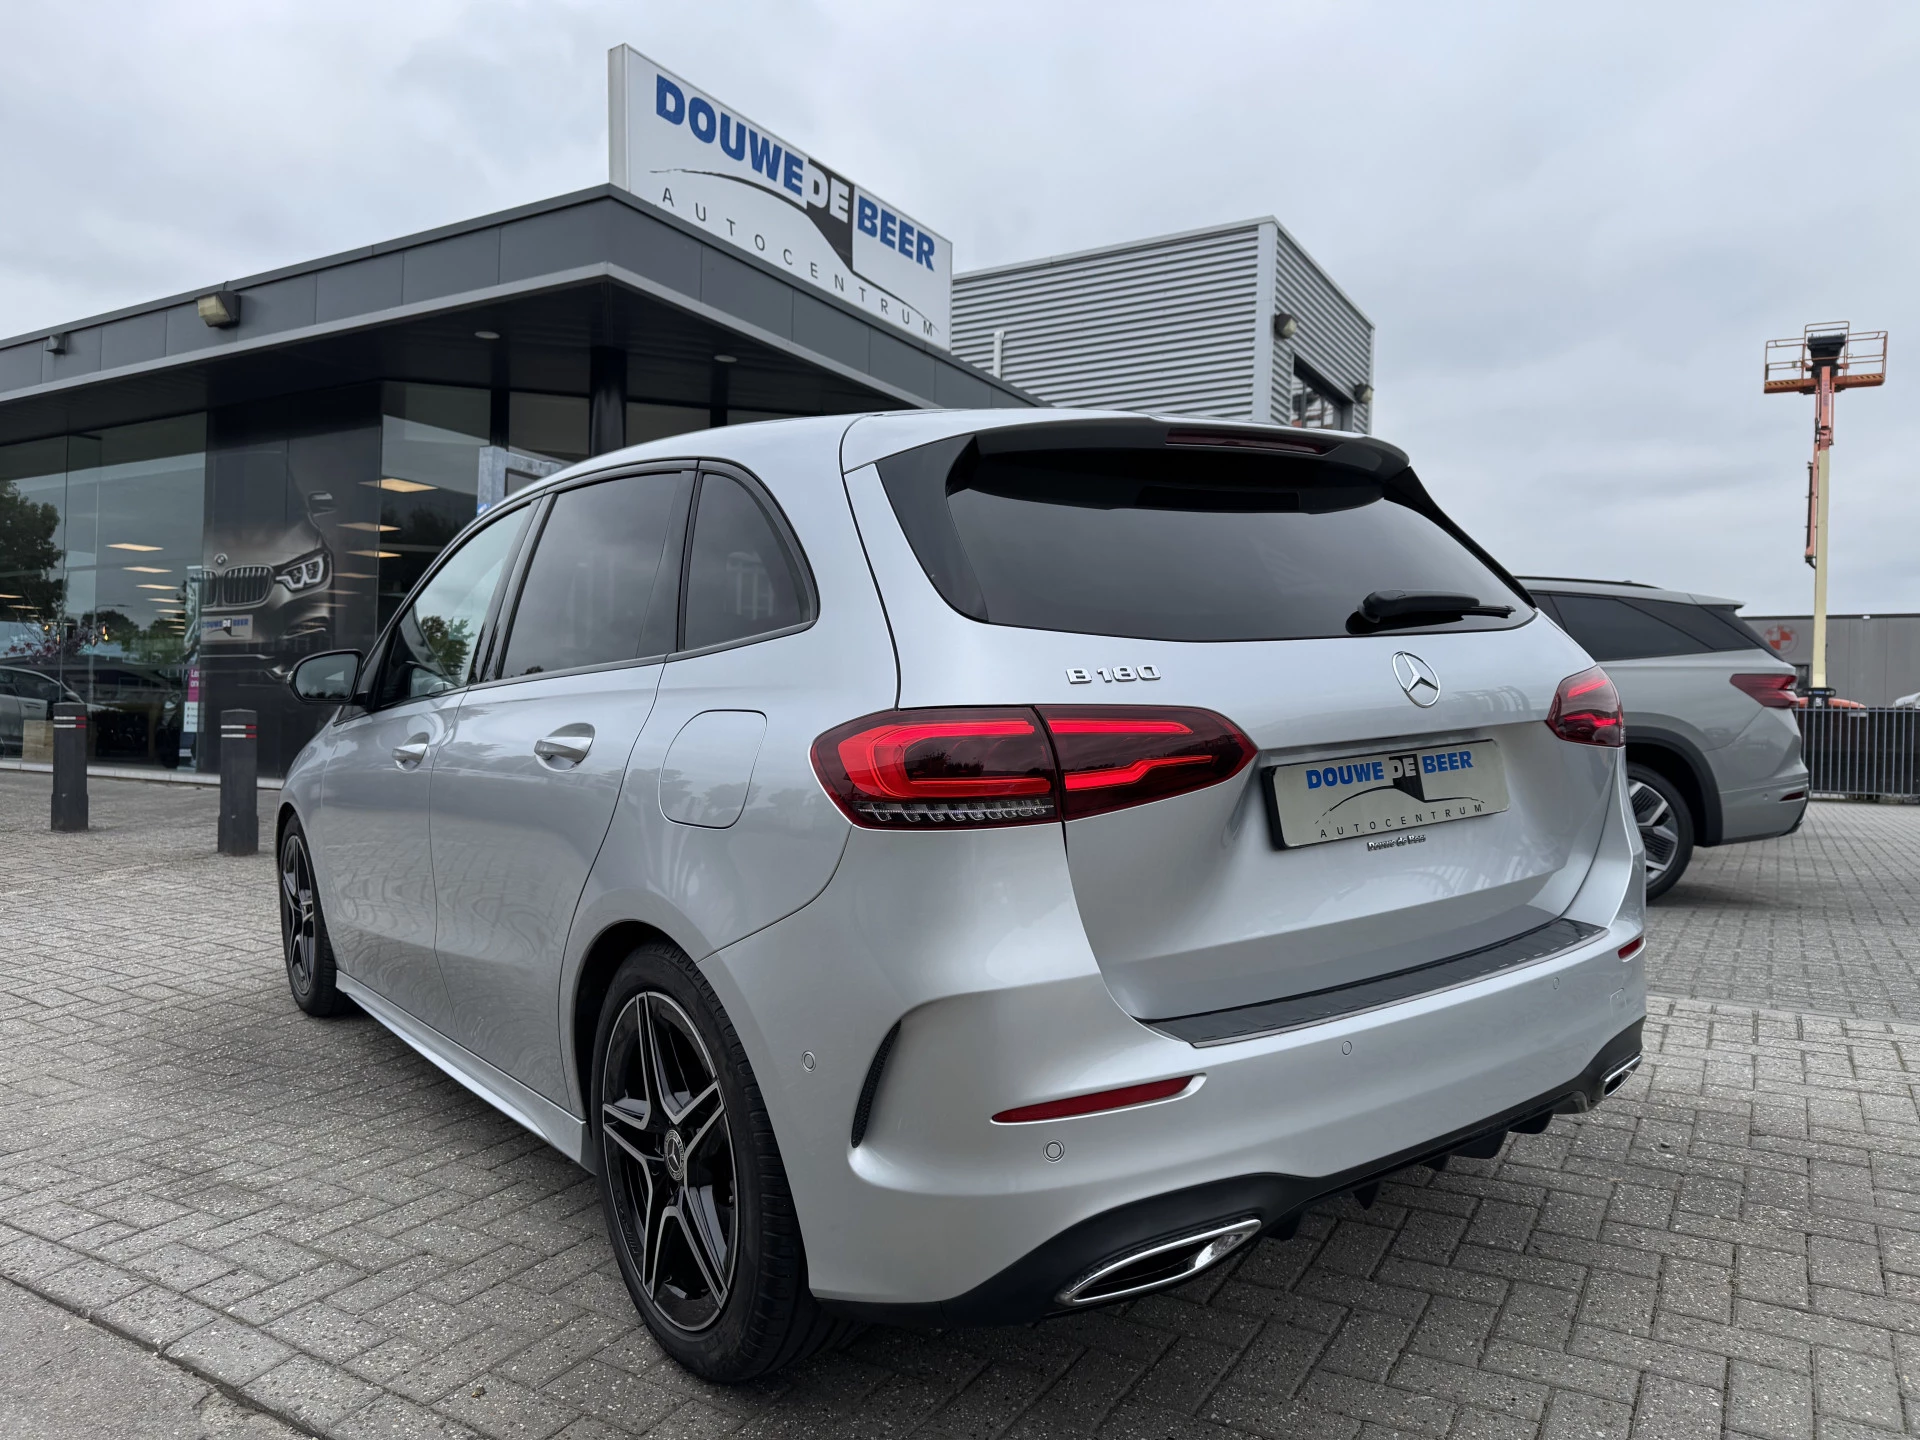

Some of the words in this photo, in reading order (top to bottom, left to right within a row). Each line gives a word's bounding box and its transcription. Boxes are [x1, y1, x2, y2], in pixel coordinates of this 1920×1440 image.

[656, 74, 803, 197] DOUWE
[804, 163, 849, 223] DE
[857, 195, 935, 272] BEER
[662, 187, 932, 336] AUTOCENTRUM
[1066, 667, 1092, 684] B
[1097, 664, 1161, 683] 180
[1306, 762, 1384, 789] DOUWE
[1391, 757, 1416, 779] DE
[1422, 751, 1473, 774] BEER
[1320, 804, 1482, 839] AUTOCENTRUM
